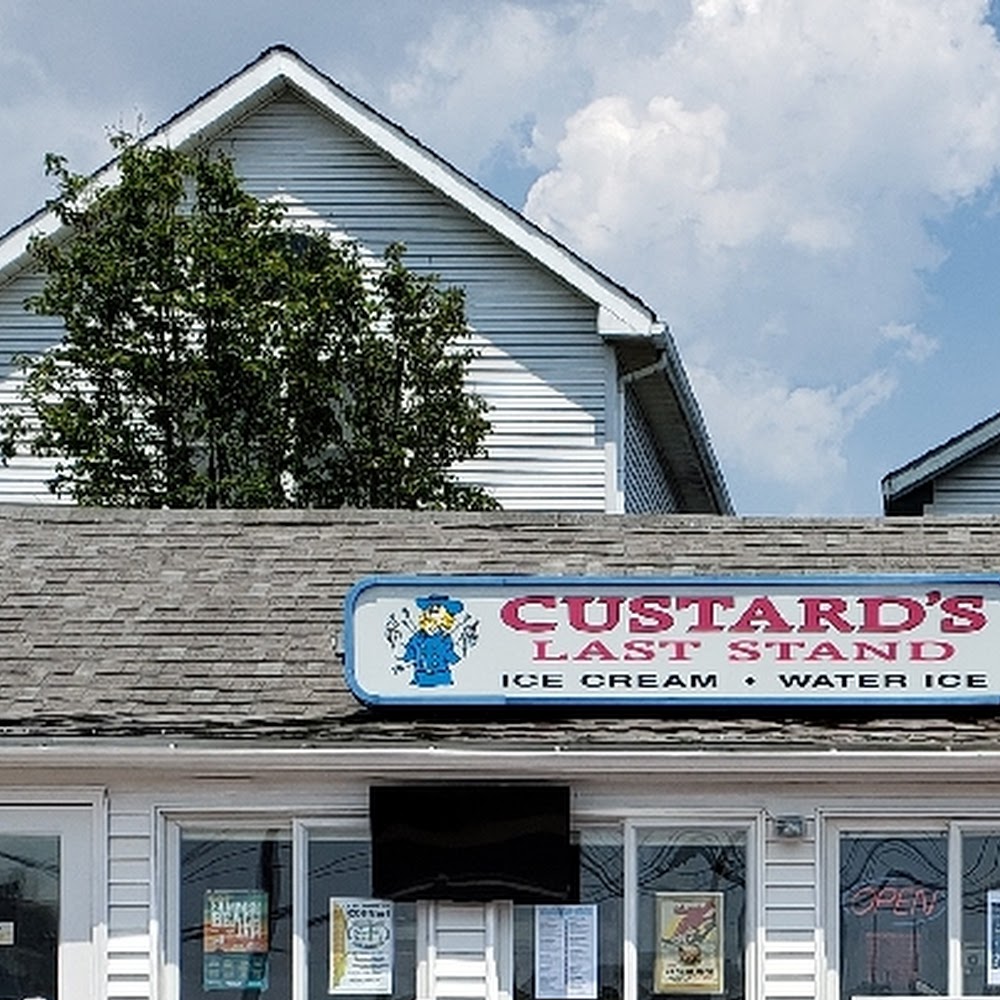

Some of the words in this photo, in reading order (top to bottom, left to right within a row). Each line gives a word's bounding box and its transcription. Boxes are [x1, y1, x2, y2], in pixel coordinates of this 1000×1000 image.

[500, 592, 987, 634] CUSTARD'S
[534, 640, 700, 662] LAST
[729, 640, 957, 662] STAND
[502, 673, 564, 689] ICE
[580, 673, 718, 689] CREAM
[778, 673, 908, 689] WATER
[924, 673, 989, 689] ICE
[851, 886, 939, 916] OPEN
